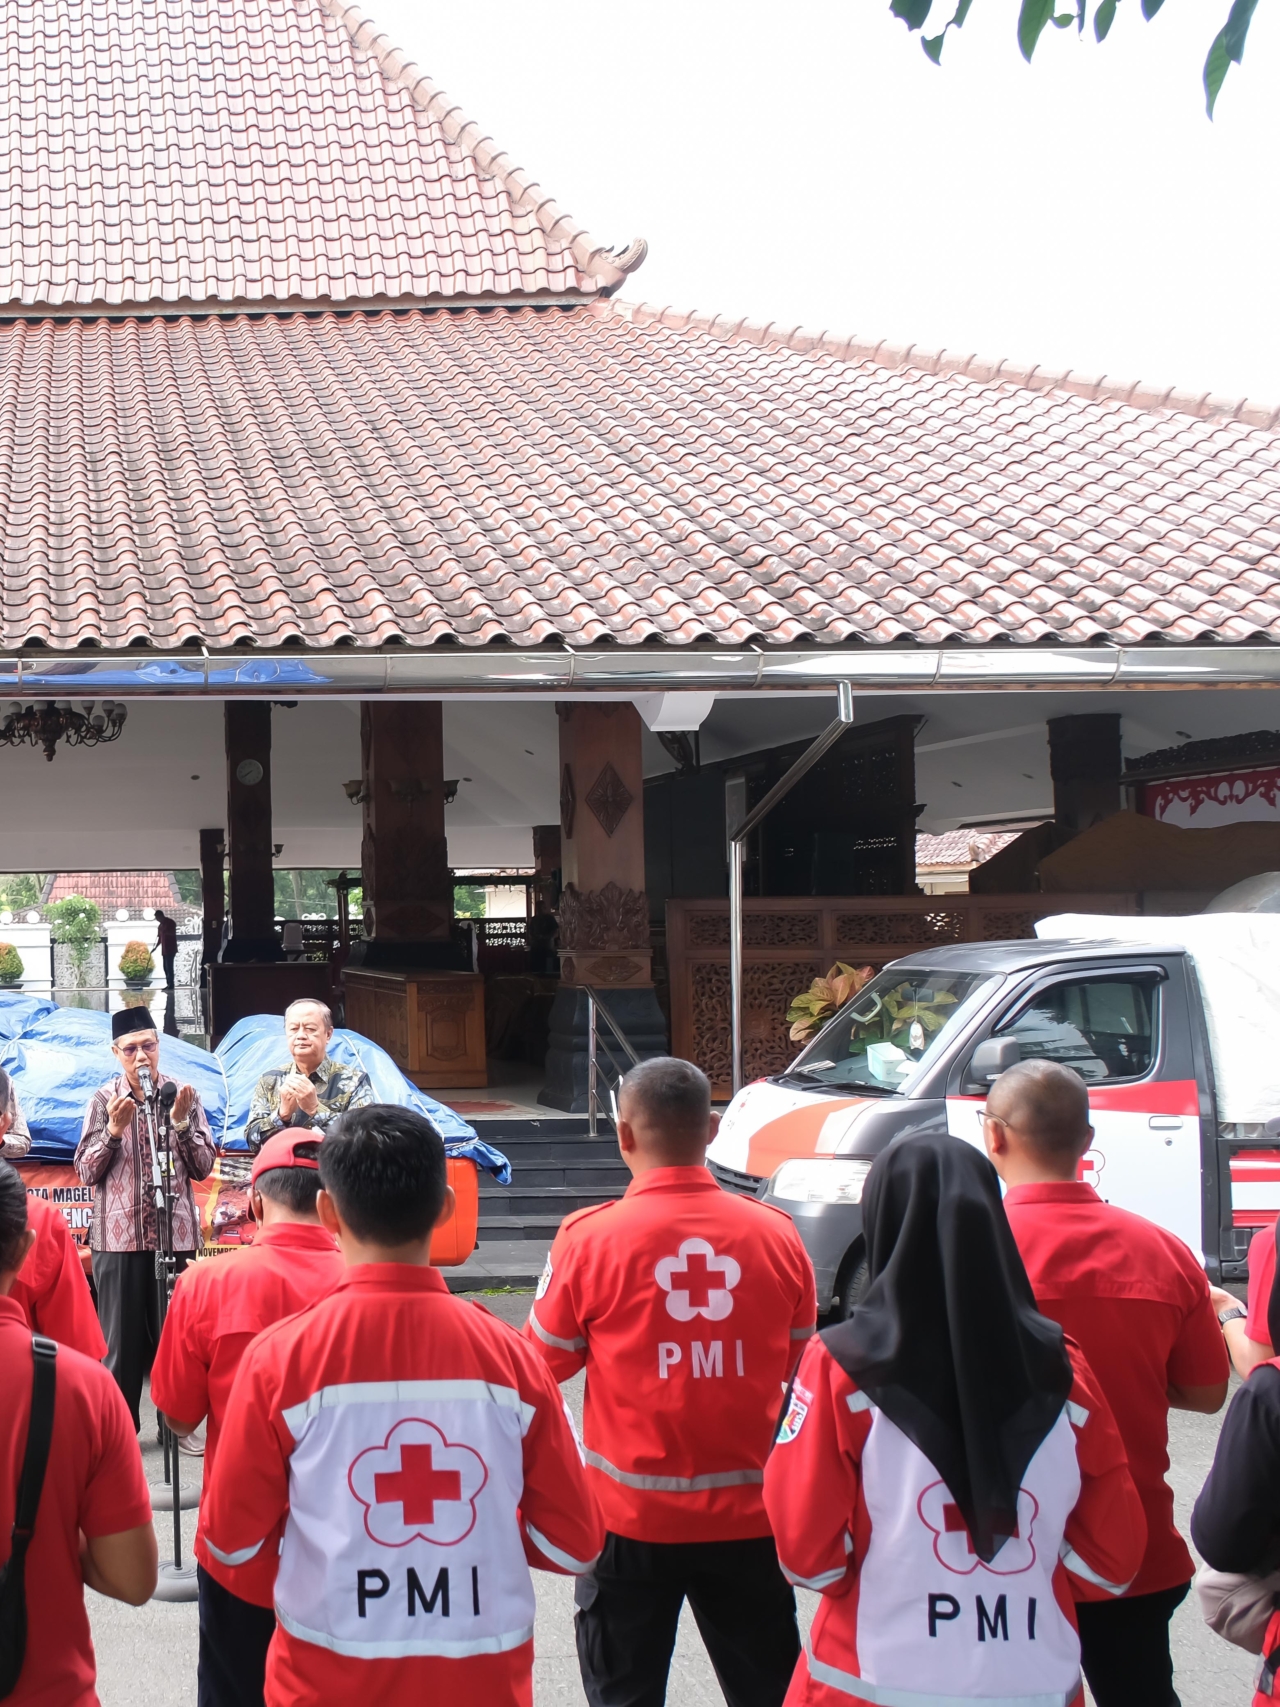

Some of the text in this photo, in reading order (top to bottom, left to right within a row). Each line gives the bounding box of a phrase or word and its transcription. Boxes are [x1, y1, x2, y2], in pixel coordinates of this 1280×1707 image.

[52, 1187, 94, 1203] MAGEL
[198, 1247, 238, 1257] NOVEM
[658, 1339, 745, 1379] PMI
[357, 1566, 480, 1618] PMI
[927, 1592, 1037, 1642] PMI
